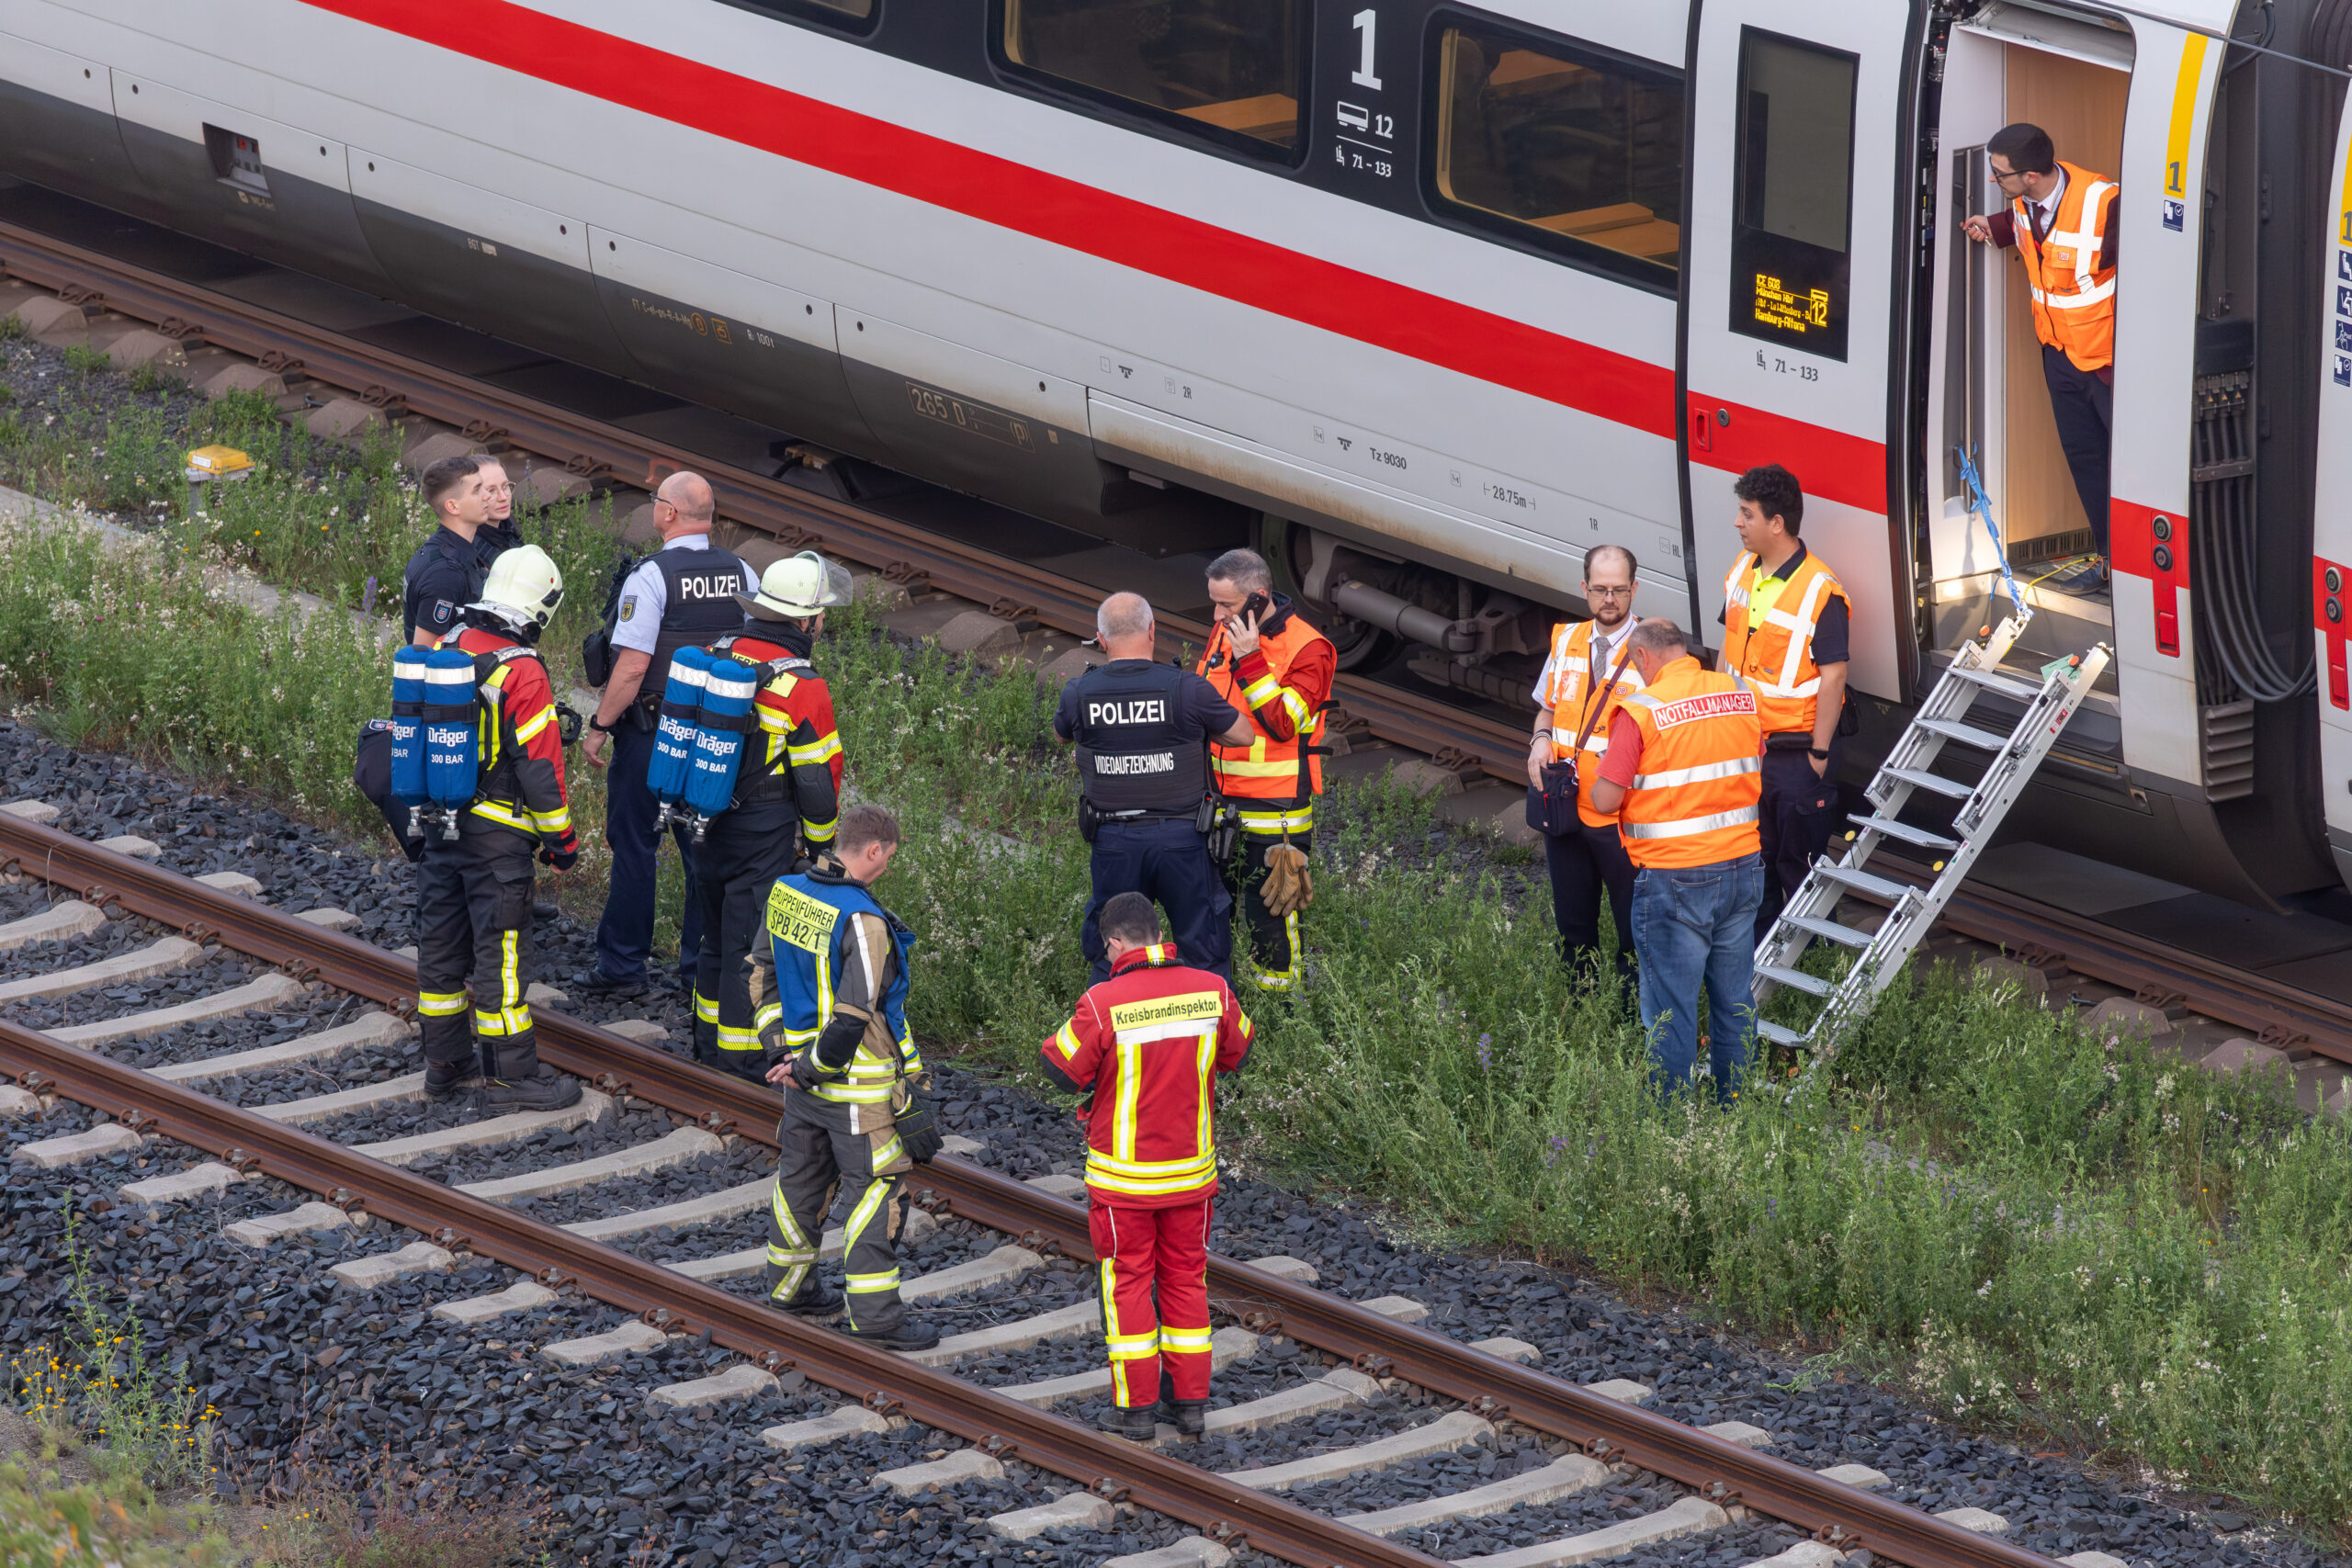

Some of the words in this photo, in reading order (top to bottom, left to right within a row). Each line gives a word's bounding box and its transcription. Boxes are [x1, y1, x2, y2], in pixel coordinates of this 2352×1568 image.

[1351, 8, 1382, 91] 1
[1375, 114, 1394, 139] 12
[1352, 154, 1363, 169] 71
[1374, 161, 1392, 177] 133
[2168, 161, 2182, 193] 1
[1756, 274, 1767, 287] ICE
[1756, 287, 1781, 301] München
[1783, 294, 1793, 304] Hbf
[1755, 308, 1805, 332] Hamburg-Altona
[1812, 301, 1827, 324] 12
[1775, 358, 1786, 373] 71
[1801, 366, 1818, 381] 133
[1182, 385, 1192, 400] 2R
[911, 388, 948, 419] 265
[953, 401, 966, 425] D
[1369, 447, 1382, 462] Tz
[1384, 451, 1407, 469] 9030
[1492, 485, 1527, 508] 28.75m
[1589, 517, 1599, 531] 1R
[1672, 544, 1681, 558] HL
[681, 574, 741, 600] POLIZEI
[1089, 700, 1165, 725] POLIZEI
[1657, 694, 1754, 726] NOTFALLMANAGER
[428, 727, 469, 747] Dräger
[659, 715, 698, 741] Dräger
[657, 741, 669, 753] 300
[670, 747, 688, 759] BAR
[696, 731, 738, 756] Dräger
[431, 753, 443, 763] 300
[445, 754, 464, 764] BAR
[695, 758, 707, 770] 300
[709, 762, 727, 773] BAR
[1094, 751, 1174, 774] VIDEOAUFZEICHNUNG
[771, 886, 834, 929] GRUPPENFÜHRER
[771, 909, 790, 936] SPB
[792, 922, 821, 950] 42/1
[1115, 998, 1216, 1025] Kreisbrandinspektor
